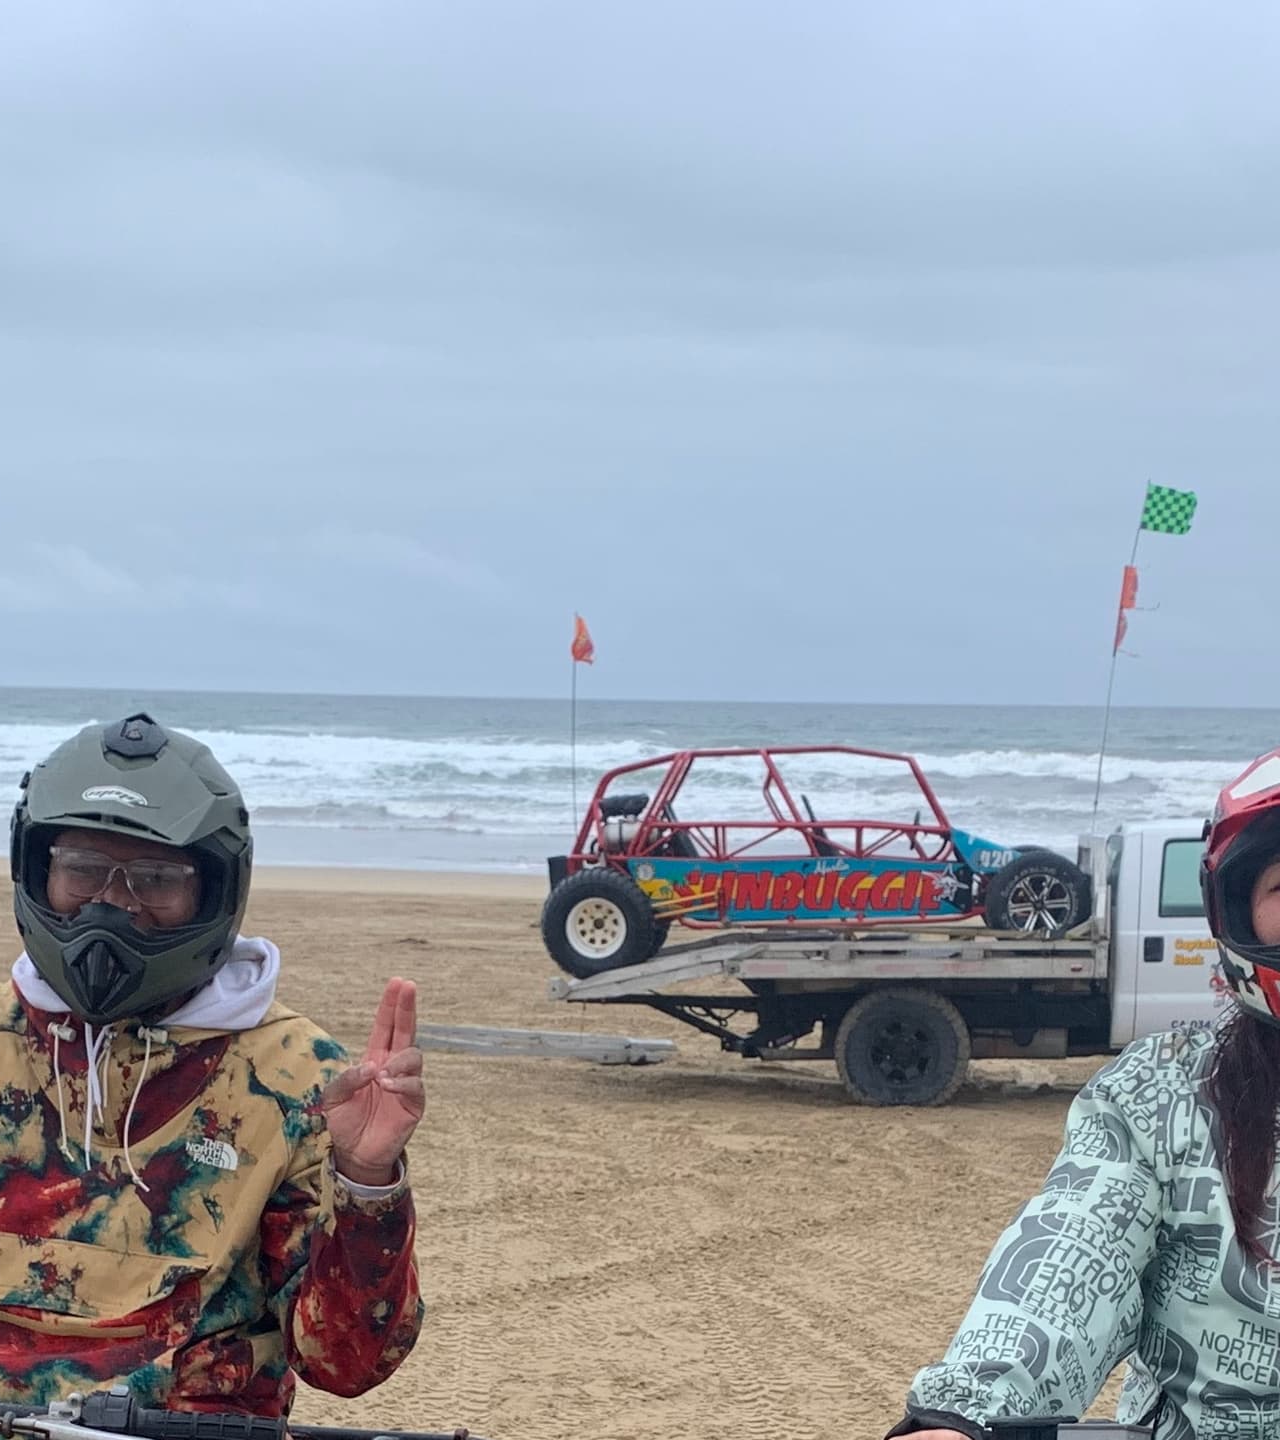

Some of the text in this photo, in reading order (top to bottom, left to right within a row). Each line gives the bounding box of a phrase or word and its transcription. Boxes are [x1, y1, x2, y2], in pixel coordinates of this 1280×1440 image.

[185, 1141, 223, 1158] NORTH
[202, 1137, 224, 1150] THE
[193, 1153, 222, 1168] FACE
[984, 1313, 1025, 1331] THE
[1238, 1318, 1277, 1347] THE
[1199, 1329, 1274, 1366] NORTH
[1216, 1354, 1270, 1385] FACE
